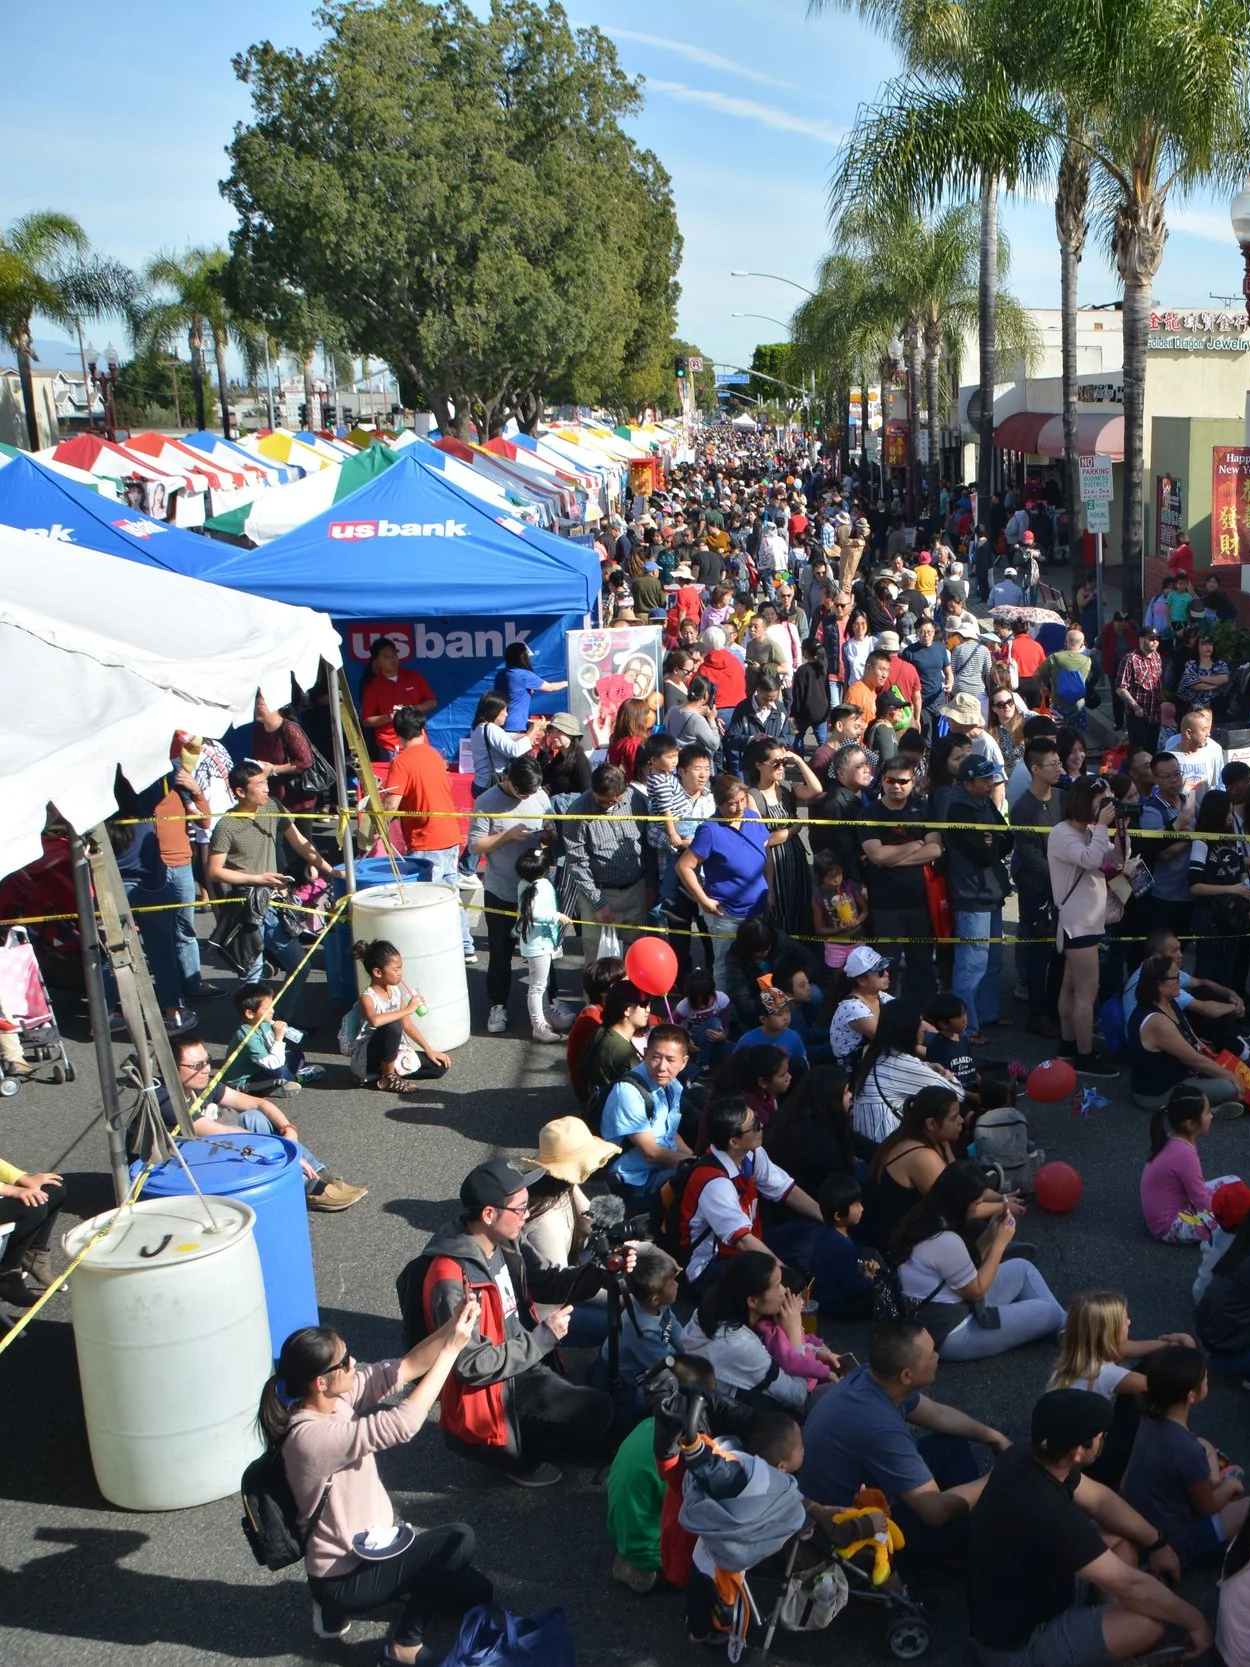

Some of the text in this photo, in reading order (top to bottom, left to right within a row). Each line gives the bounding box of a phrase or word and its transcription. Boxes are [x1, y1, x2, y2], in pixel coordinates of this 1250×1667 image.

[1175, 338, 1204, 351] Dragon
[1081, 457, 1093, 467] NO
[1082, 468, 1110, 476] PARKING
[1218, 465, 1240, 475] New
[1087, 500, 1094, 509] 2
[1219, 505, 1240, 557] 發財
